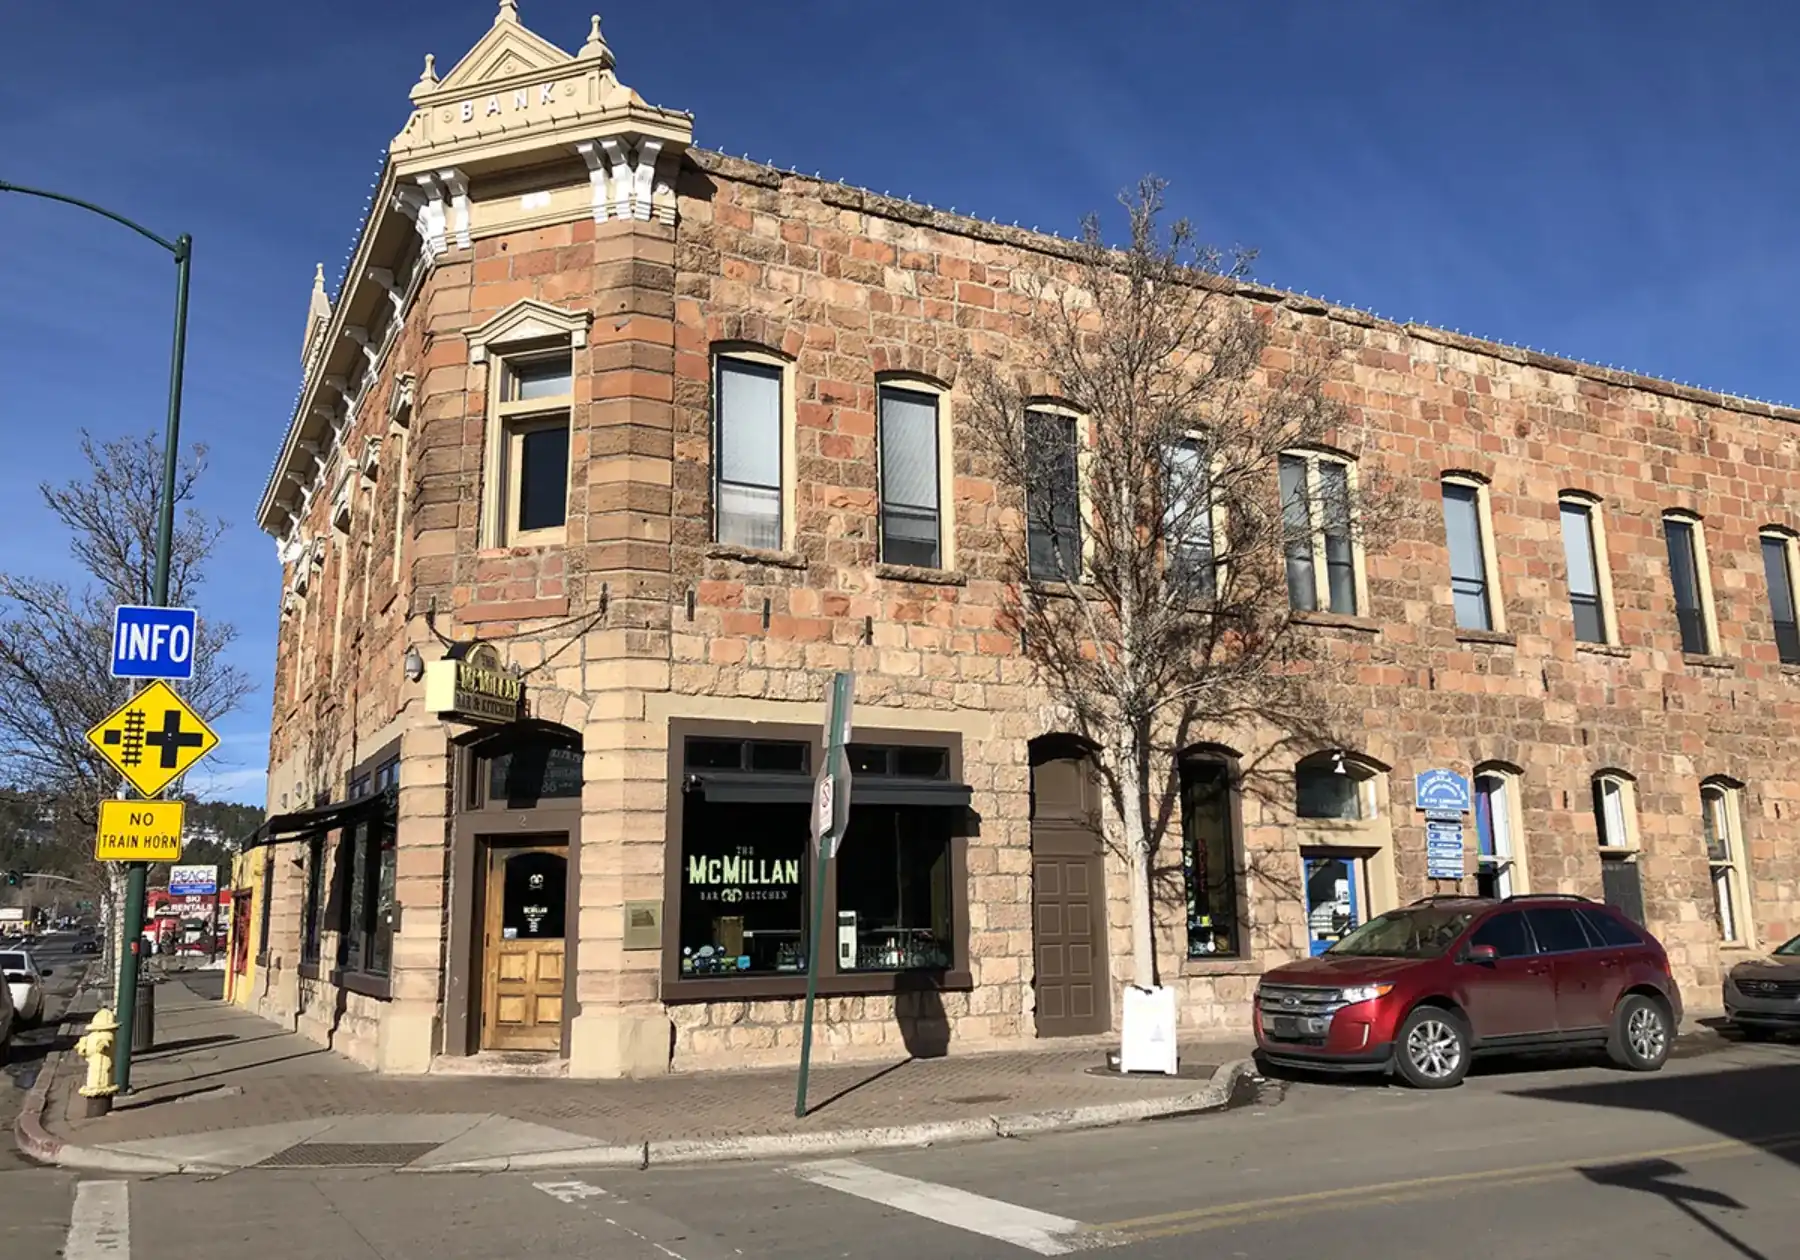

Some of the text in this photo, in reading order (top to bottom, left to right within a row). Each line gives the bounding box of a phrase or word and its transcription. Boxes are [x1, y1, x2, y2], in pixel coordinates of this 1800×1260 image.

[460, 82, 556, 123] BANK
[117, 623, 190, 662] INFO
[129, 812, 154, 826] NO
[519, 815, 527, 827] 2
[102, 834, 178, 850] TRAIN HORN
[736, 846, 754, 856] THE
[173, 869, 213, 882] PEACE
[185, 895, 202, 904] SKI
[700, 890, 789, 901] BAR KITCHEN
[170, 903, 213, 912] RENTALS
